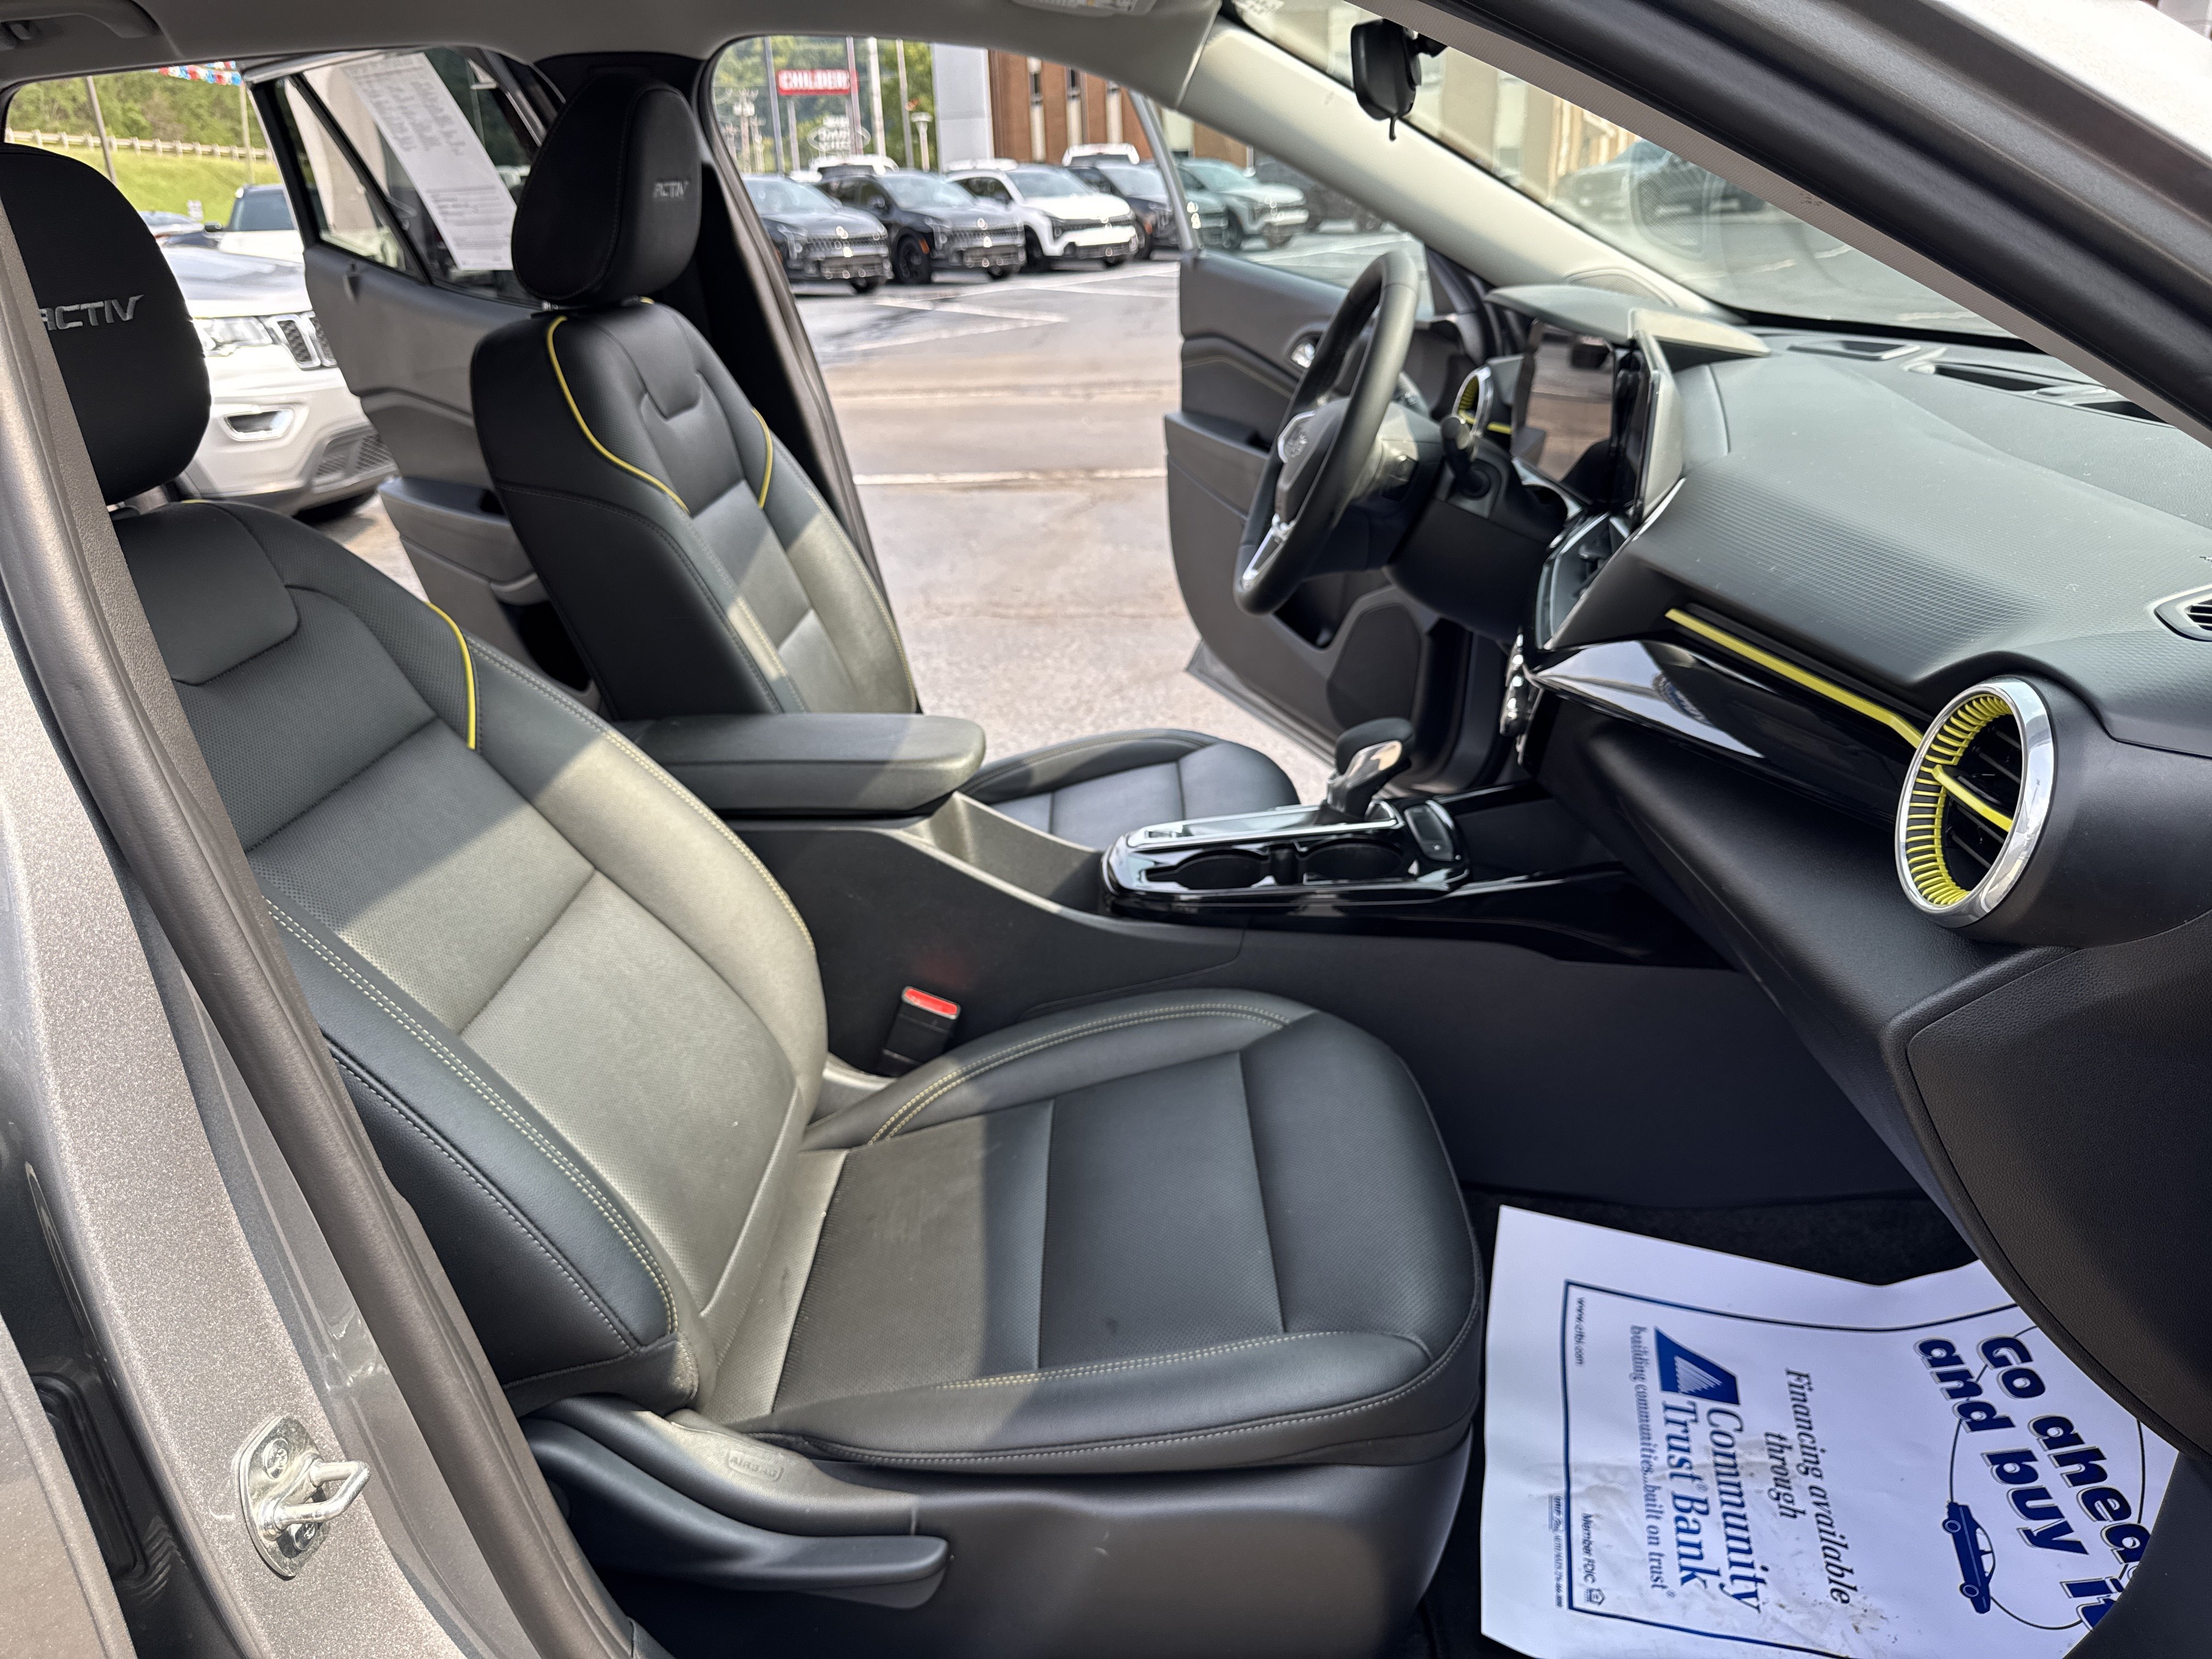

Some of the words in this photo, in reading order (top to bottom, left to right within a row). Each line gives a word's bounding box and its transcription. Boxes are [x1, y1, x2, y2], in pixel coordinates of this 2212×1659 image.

[778, 70, 850, 89] CHILDER
[1629, 1325, 1647, 1381] building
[1646, 1525, 1661, 1546] on
[1706, 1408, 1769, 1613] Community
[1763, 1432, 1805, 1519] through
[1784, 1368, 1825, 1480] Financing
[1807, 1486, 1857, 1604] available
[1914, 1339, 2015, 1433] and
[1980, 1449, 2089, 1555] buy
[1977, 1337, 2045, 1399] Go
[2028, 1414, 2151, 1577] ahea
[1581, 1513, 1593, 1556] Member
[1583, 1558, 1596, 1583] FDIC
[1670, 1491, 1719, 1590] Bank
